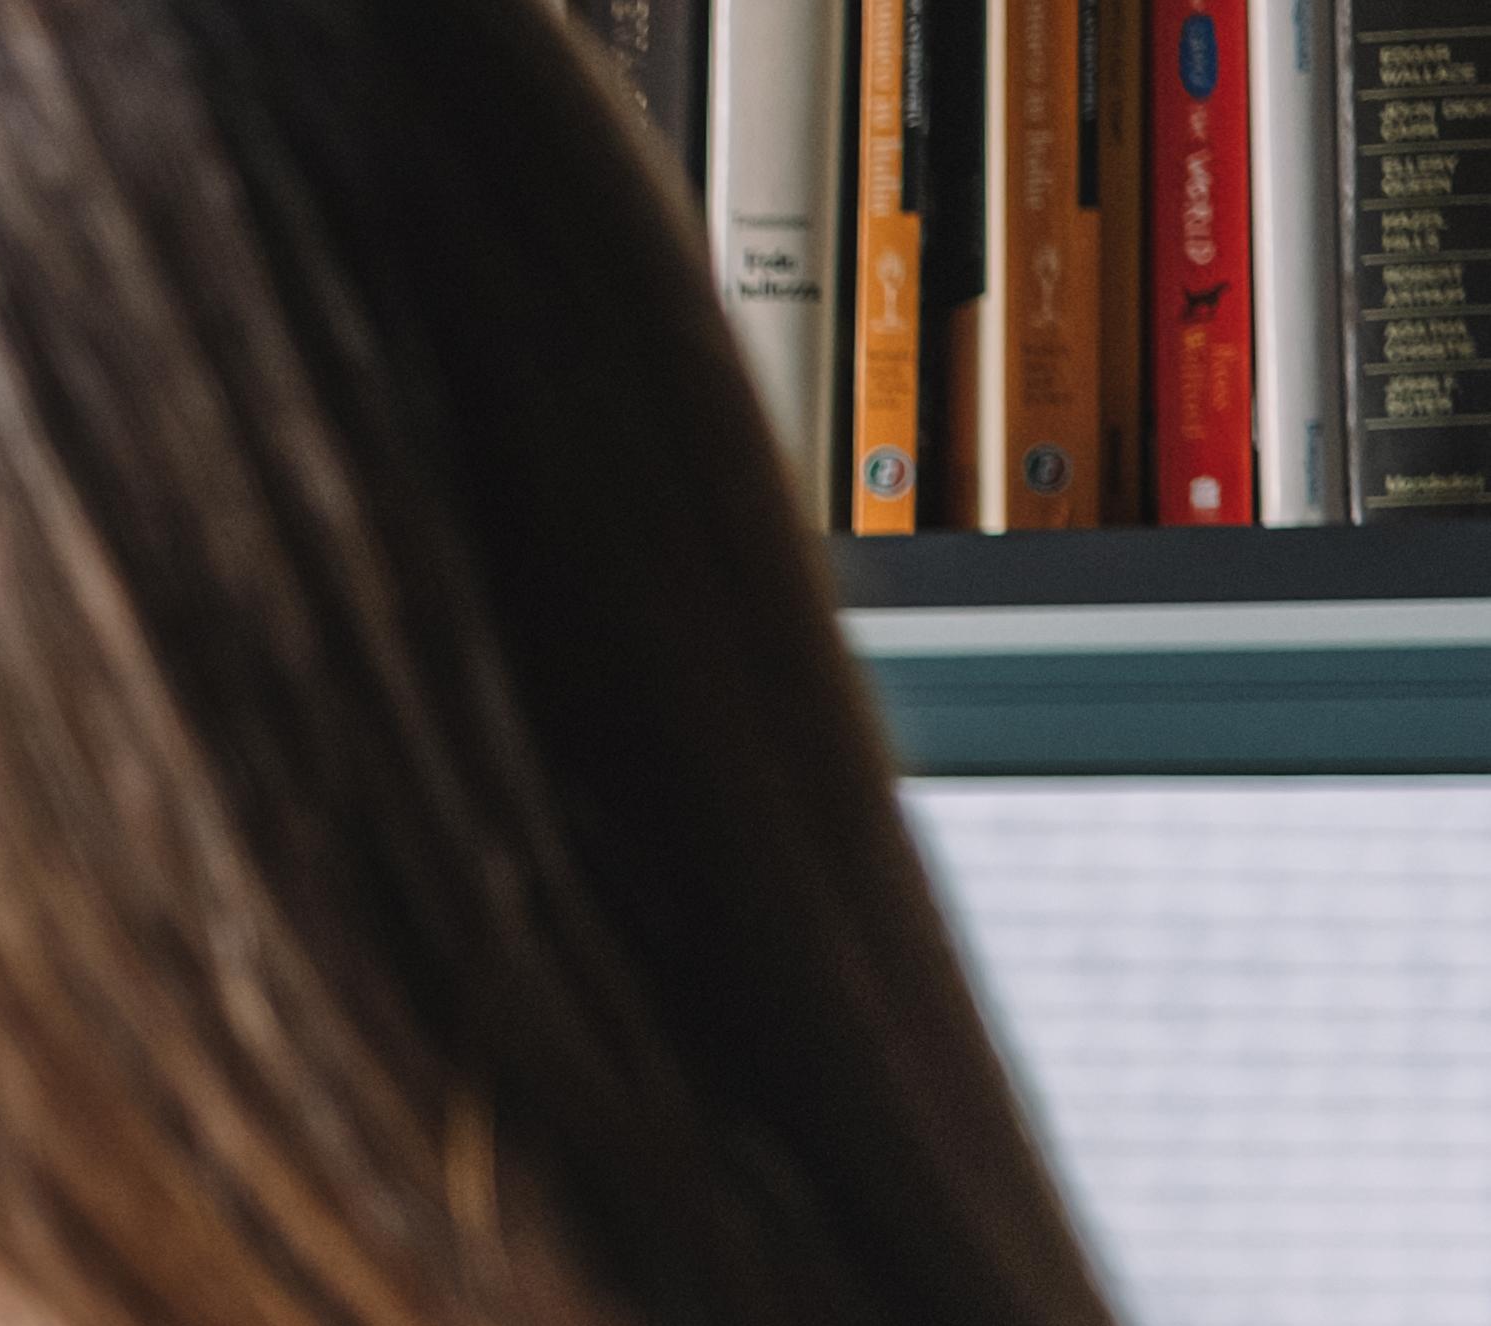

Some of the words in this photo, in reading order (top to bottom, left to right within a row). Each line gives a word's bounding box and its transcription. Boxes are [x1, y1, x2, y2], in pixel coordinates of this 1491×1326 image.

[1379, 62, 1476, 87] WALLACE
[1381, 153, 1460, 176] ELLERY
[1383, 338, 1475, 363] CHRISTIE
